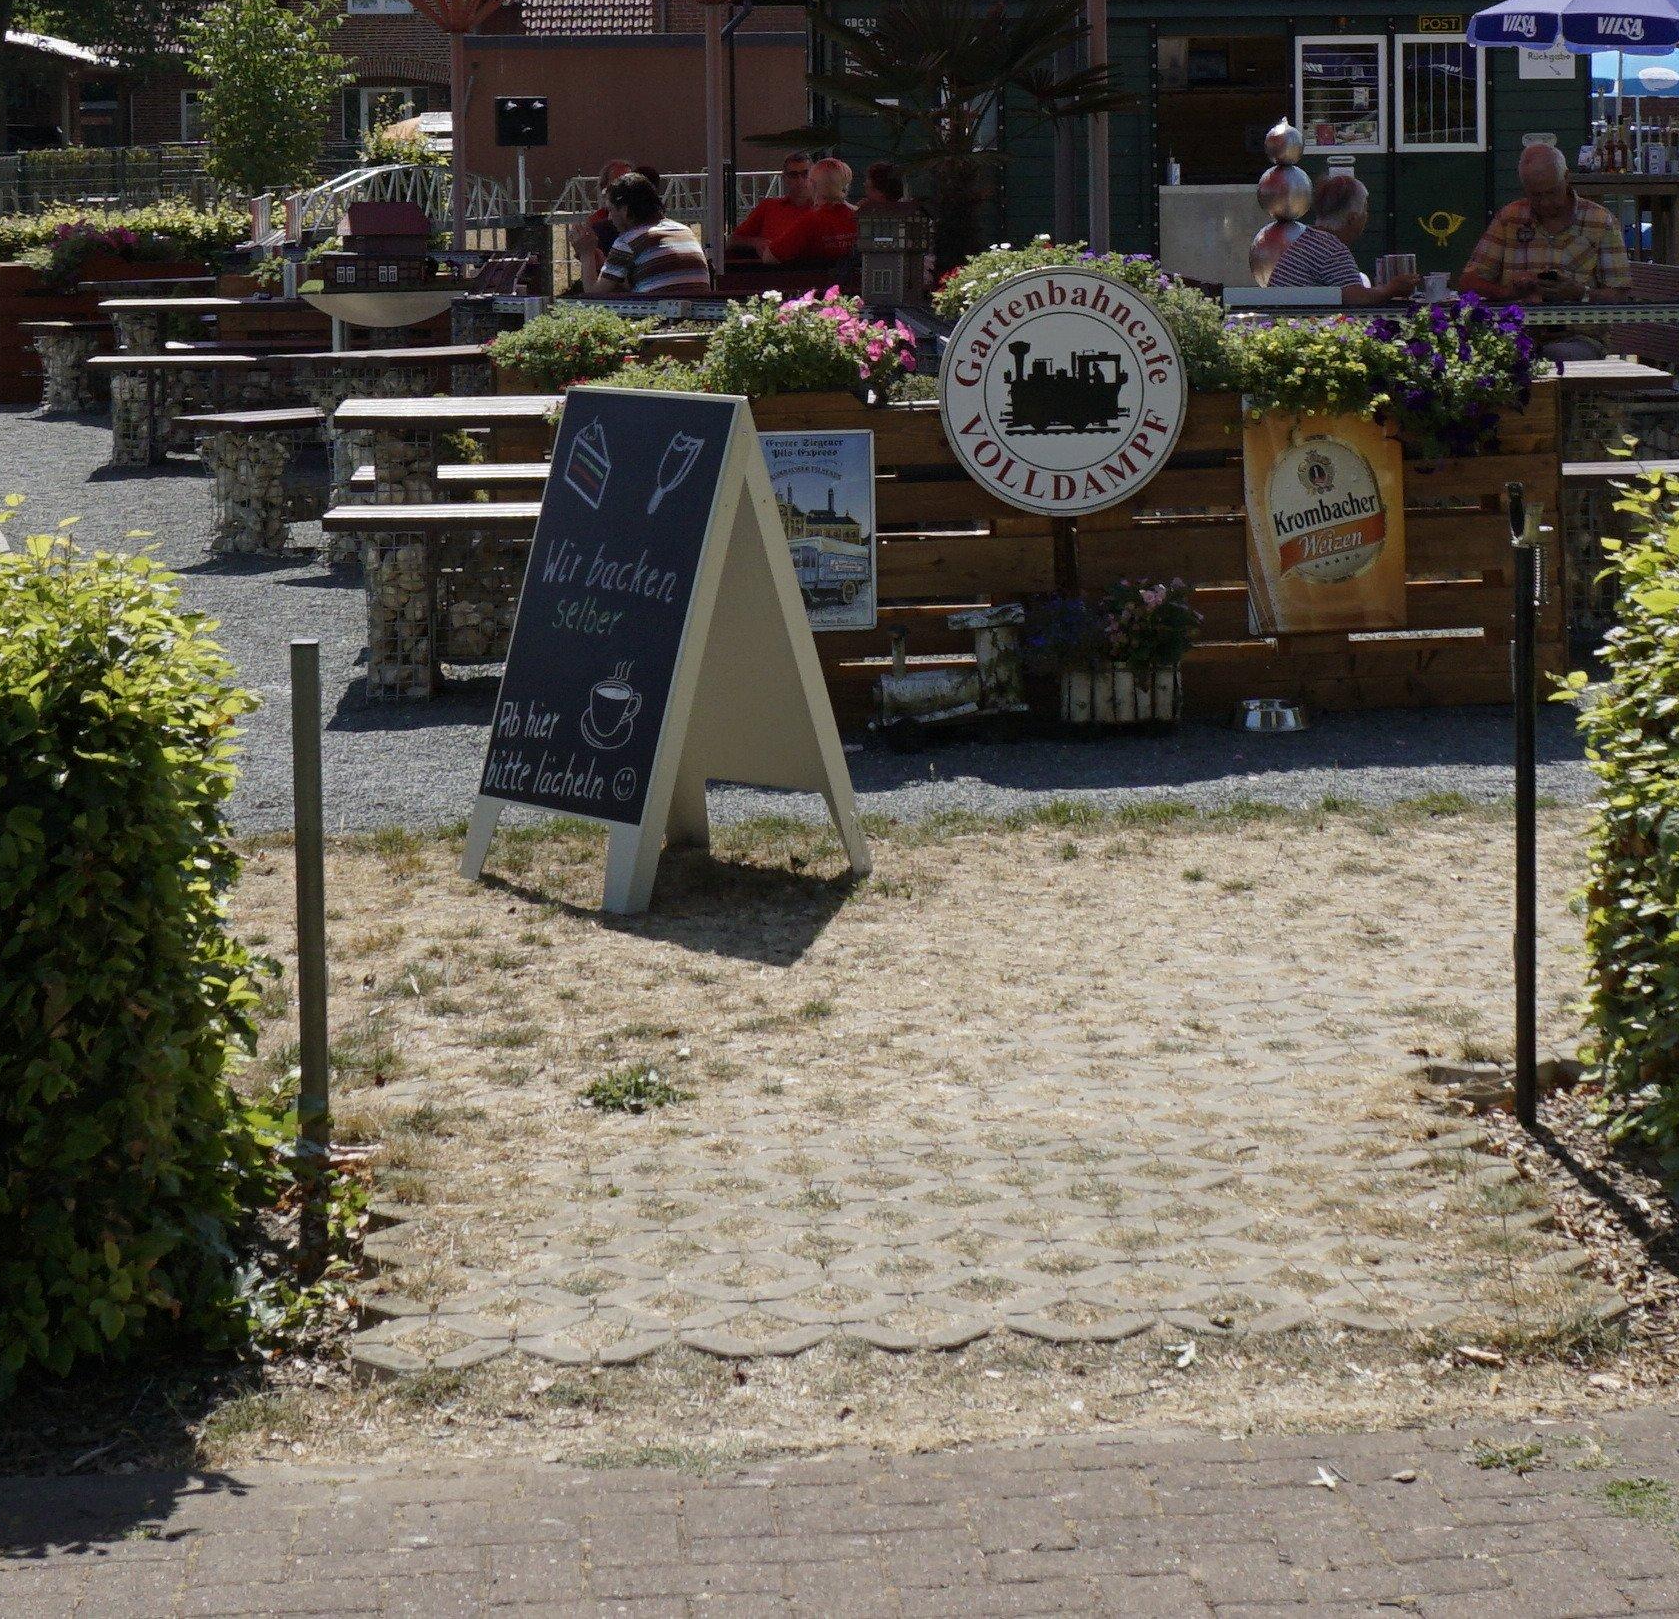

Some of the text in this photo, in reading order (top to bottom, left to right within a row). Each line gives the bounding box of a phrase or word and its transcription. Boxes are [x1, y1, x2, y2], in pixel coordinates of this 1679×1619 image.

[1421, 16, 1459, 31] POST
[1502, 15, 1537, 38] VILSA
[1596, 16, 1645, 41] VILSA
[954, 279, 1173, 388] Gartenbahncafe
[959, 408, 1170, 501] VOLLDAMPF
[1274, 492, 1376, 536] Krombacher
[1297, 530, 1364, 560] Weizen
[542, 539, 678, 603] Wir backen
[552, 595, 623, 635] selber
[498, 699, 560, 740] Ab hier
[484, 748, 604, 801] bitte lächeln
